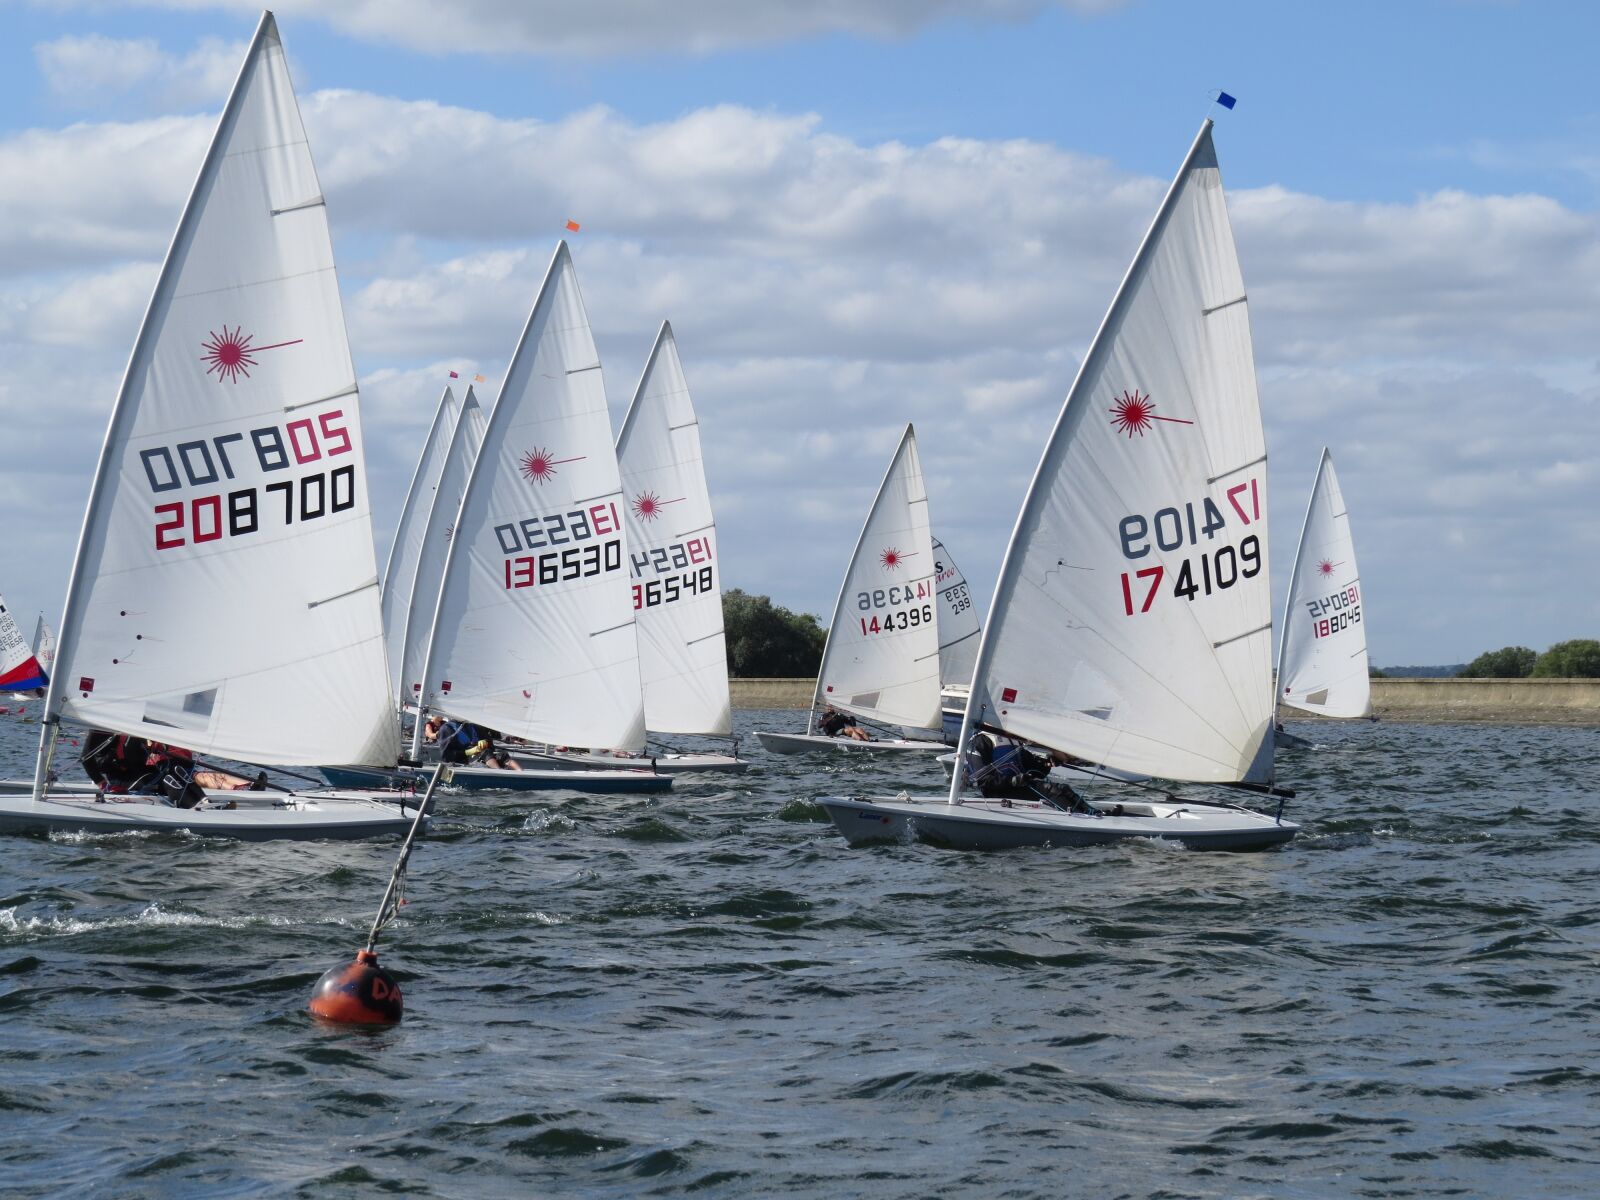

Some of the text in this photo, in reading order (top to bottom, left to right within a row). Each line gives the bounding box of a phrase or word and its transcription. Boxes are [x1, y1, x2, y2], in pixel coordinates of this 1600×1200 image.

[155, 464, 354, 550] 208700
[505, 539, 620, 590] 136530
[1120, 534, 1261, 616] 174109
[860, 604, 932, 636] 144396
[951, 597, 971, 615] 299
[1313, 605, 1361, 639] 188045
